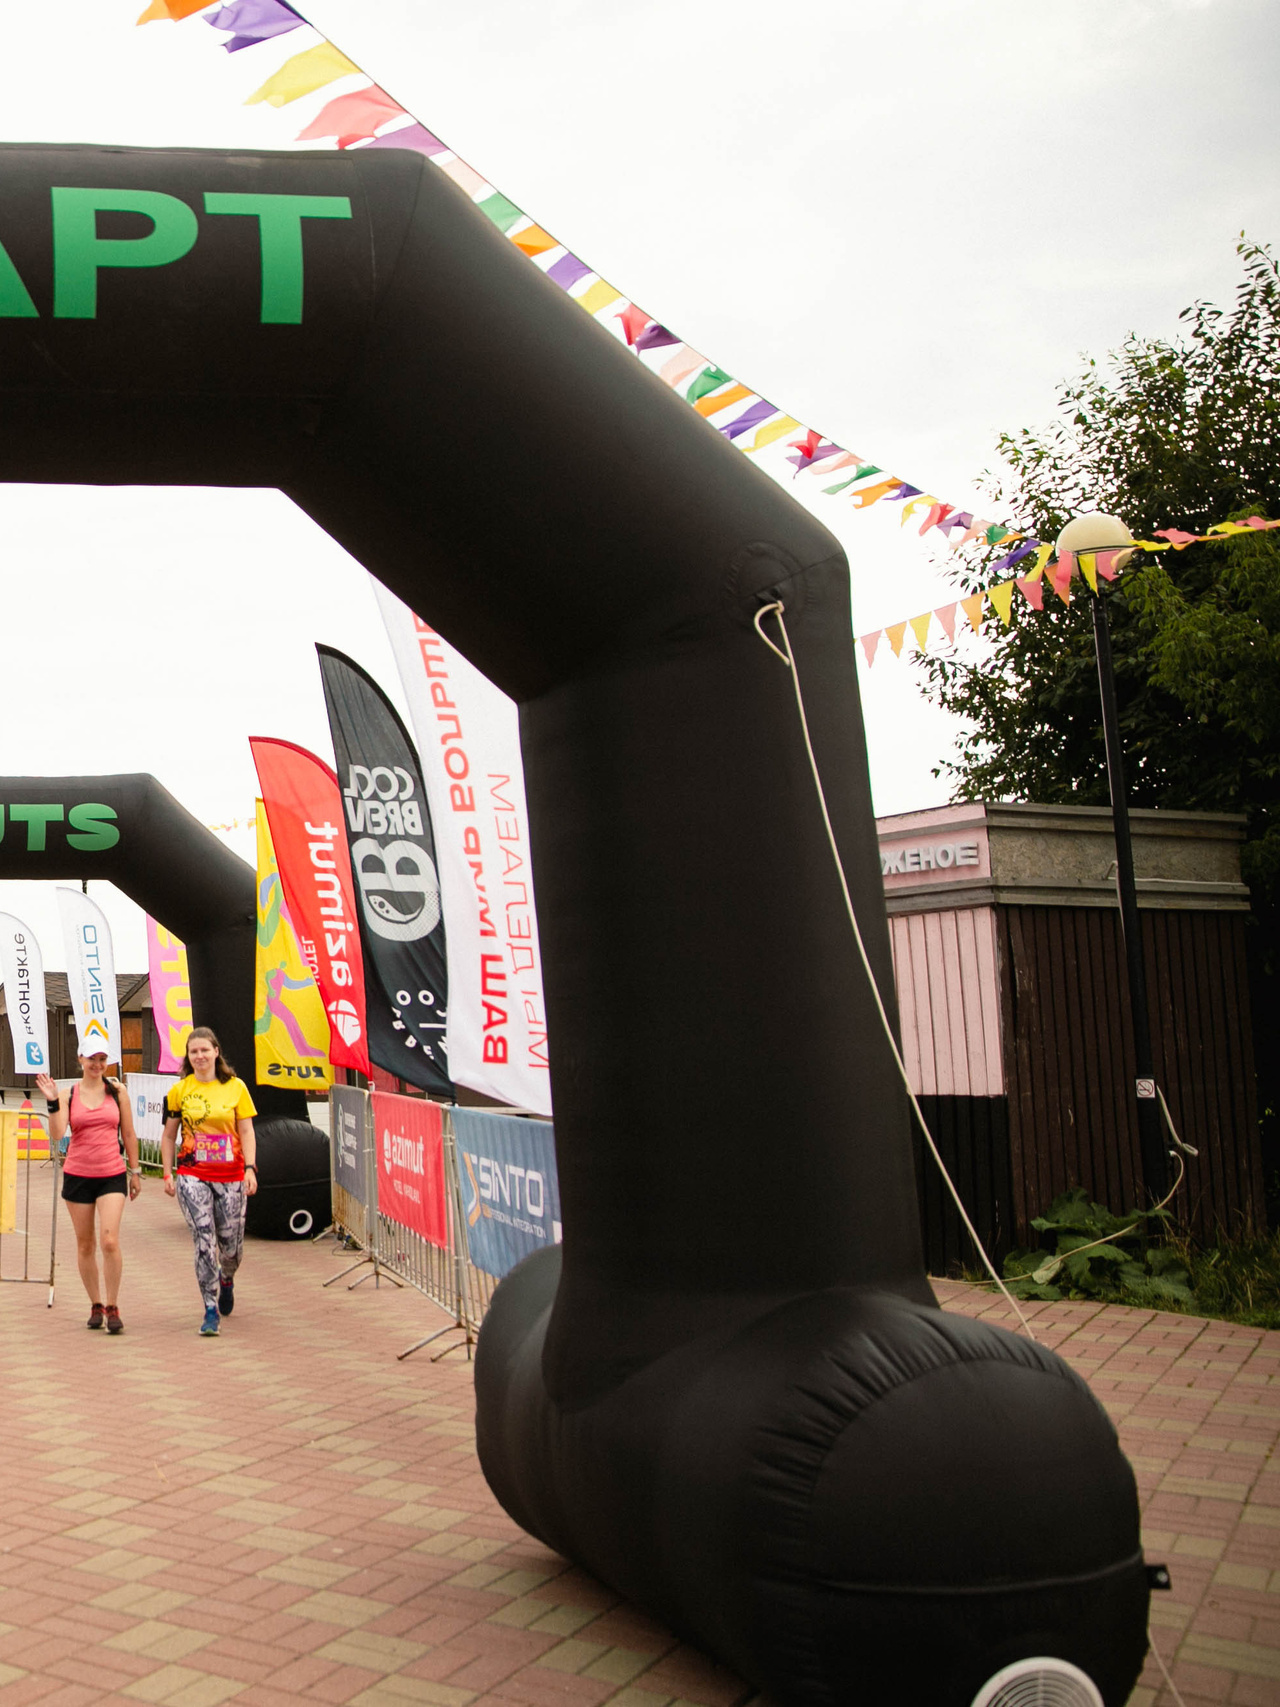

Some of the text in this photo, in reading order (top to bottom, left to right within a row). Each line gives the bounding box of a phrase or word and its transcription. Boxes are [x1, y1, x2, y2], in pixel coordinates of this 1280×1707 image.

[197, 1141, 220, 1151] 014
[391, 1125, 424, 1176] azimut
[479, 1156, 544, 1218] SINTO
